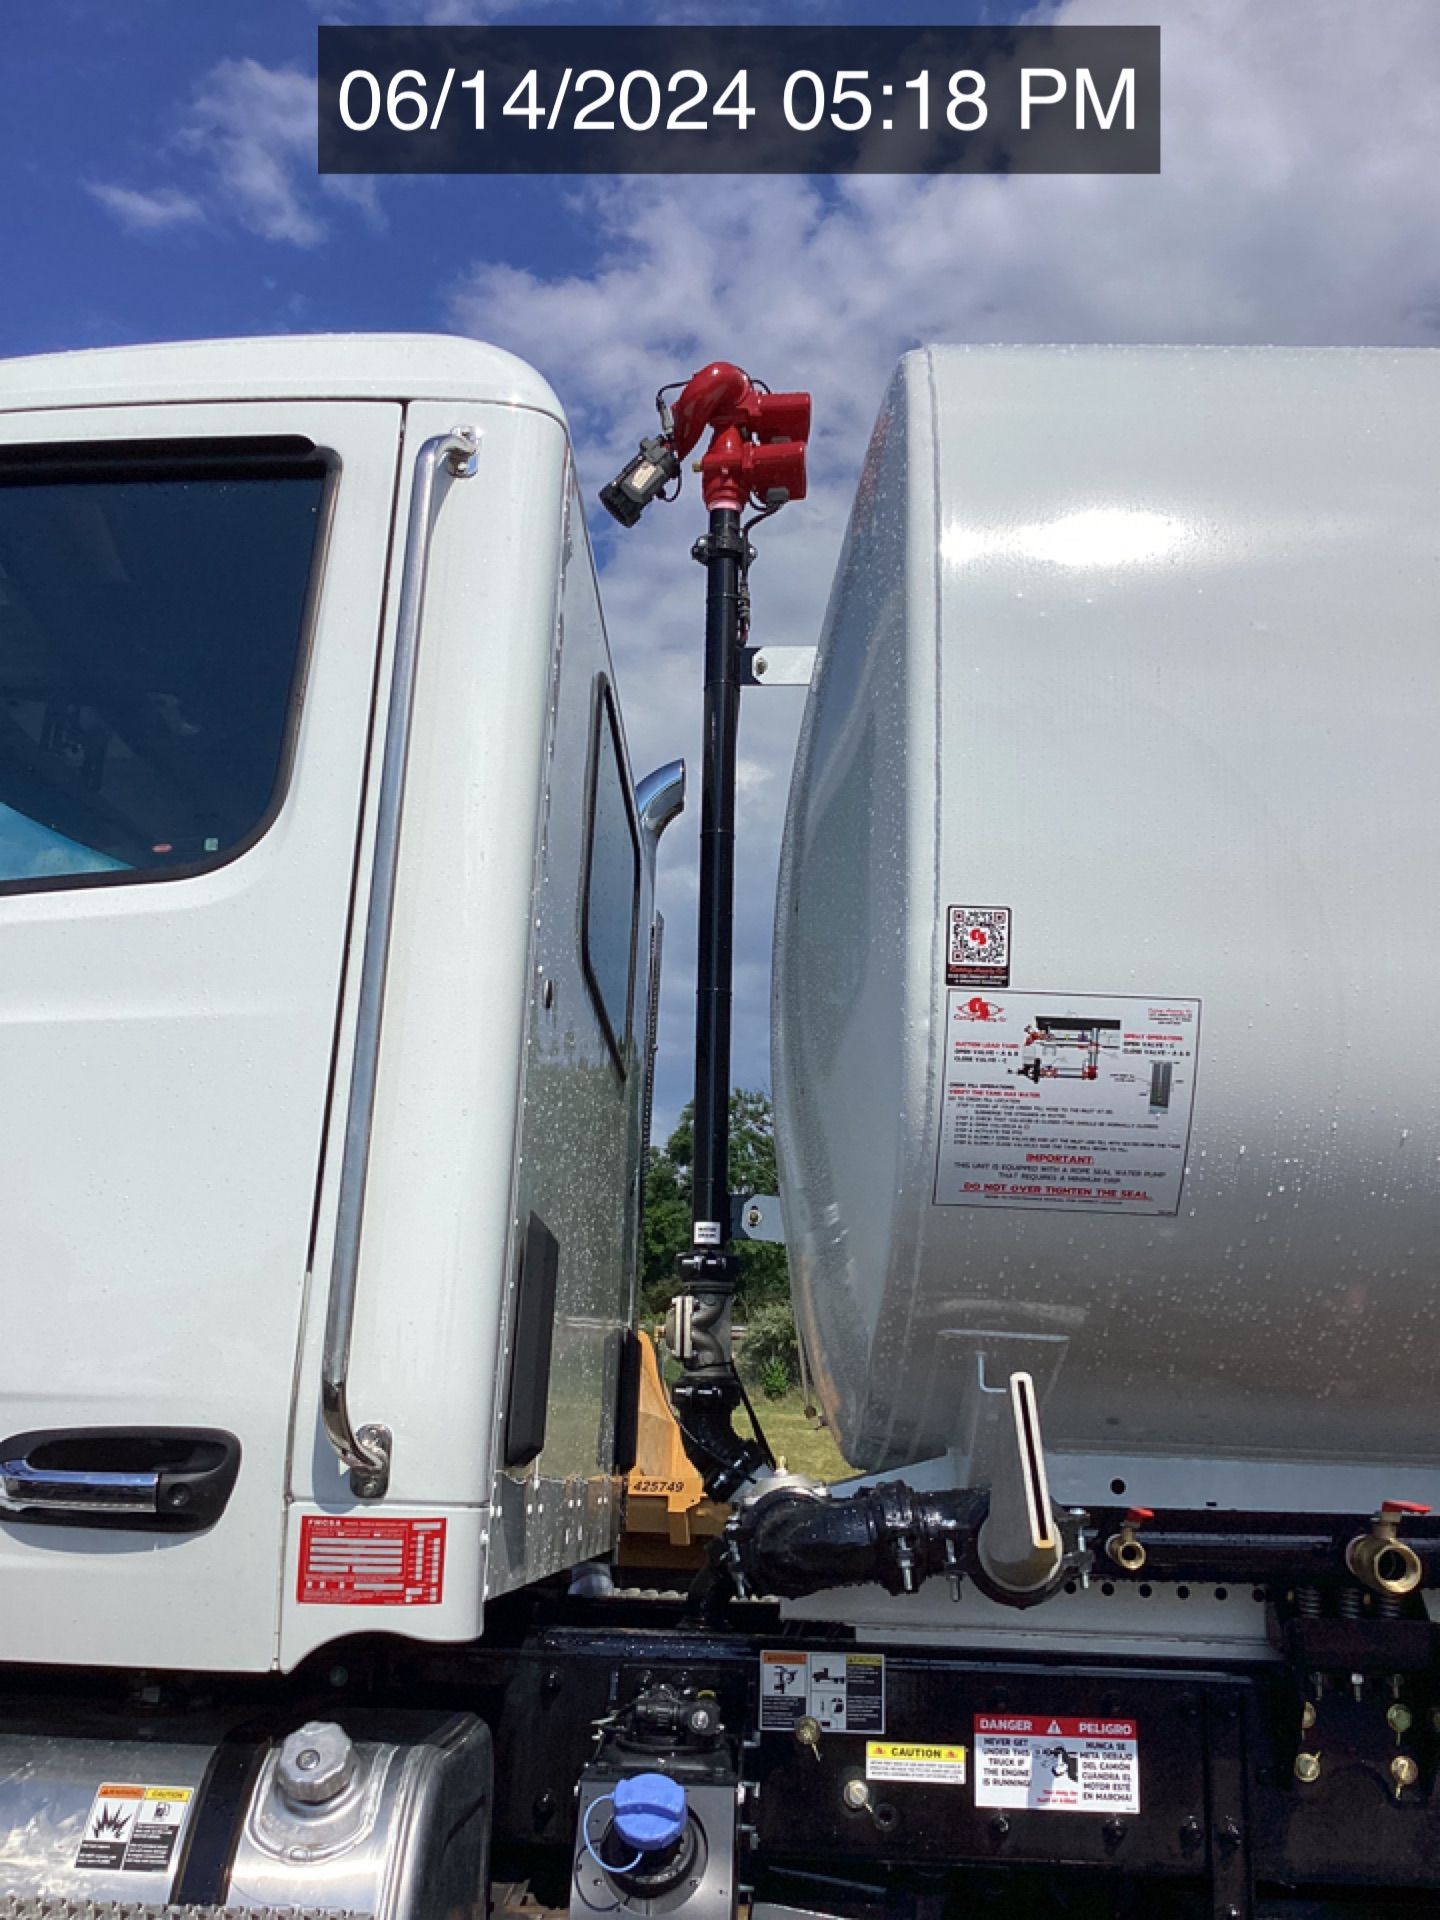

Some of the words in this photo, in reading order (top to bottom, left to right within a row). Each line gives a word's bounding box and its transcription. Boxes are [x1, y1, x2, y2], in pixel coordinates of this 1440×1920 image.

[1001, 1164, 1038, 1172] EQUIPPED
[1115, 1169, 1142, 1177] WATER
[998, 1171, 1018, 1179] THAT
[1021, 1173, 1057, 1181] REQUIRES
[964, 1182, 980, 1192] DO
[984, 1183, 1006, 1192] NOT
[1010, 1185, 1041, 1193] OVER
[1045, 1186, 1092, 1195] TIGHTEN
[1096, 1188, 1117, 1197] THE
[1121, 1189, 1147, 1198] SEAL
[633, 1481, 685, 1492] 425749
[980, 1719, 1032, 1731] DANGER
[1079, 1723, 1133, 1735] PELIGRO
[1013, 1738, 1029, 1746] GET
[1085, 1741, 1113, 1749] NUNCA
[1115, 1742, 1126, 1750] SE
[891, 1747, 941, 1758] CAUTION
[982, 1748, 1011, 1756] UNDER
[1013, 1749, 1030, 1757] THIS
[1103, 1753, 1133, 1761] DEBAJO
[988, 1758, 1014, 1766] TRUCK
[1017, 1758, 1025, 1766] IF
[1082, 1762, 1097, 1770] DEL
[983, 1768, 999, 1776] THE
[1001, 1769, 1029, 1777] ENGINE
[1121, 1773, 1132, 1781] EL
[982, 1778, 991, 1786] IS
[1083, 1782, 1110, 1790] MOTOR
[1082, 1792, 1095, 1800] EN
